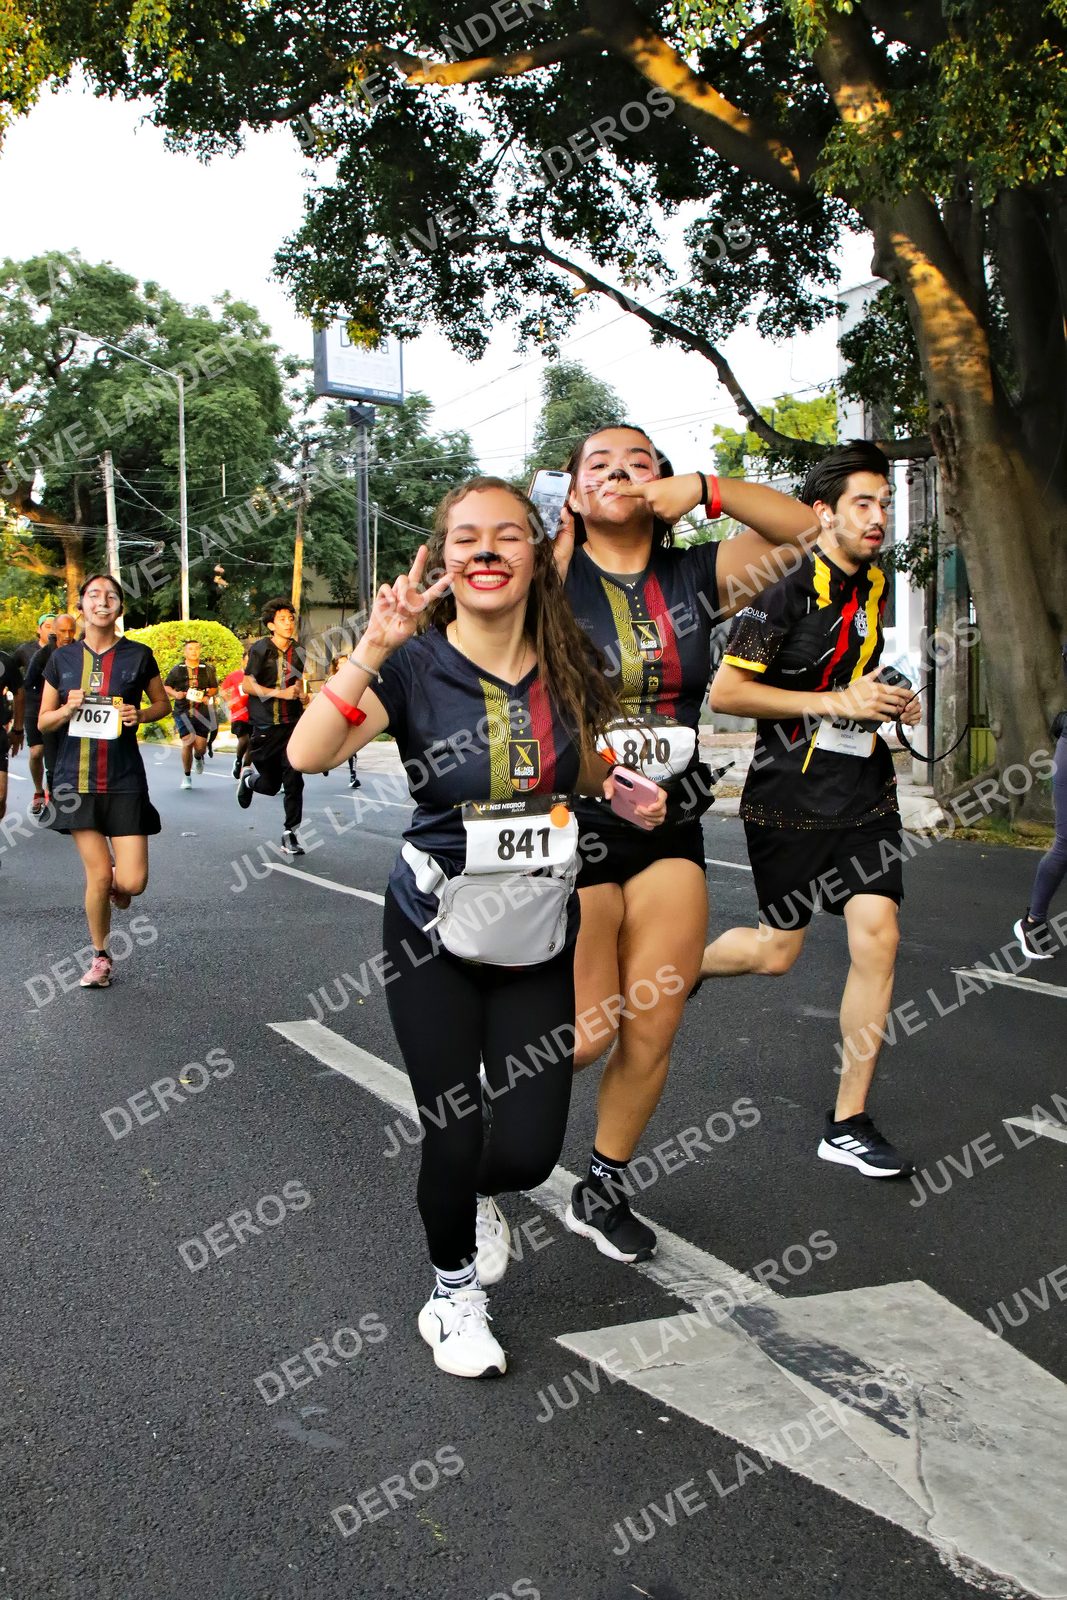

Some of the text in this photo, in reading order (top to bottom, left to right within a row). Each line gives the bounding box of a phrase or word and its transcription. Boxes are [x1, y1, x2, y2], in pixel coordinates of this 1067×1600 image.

[76, 709, 111, 724] 7067
[623, 738, 671, 766] 840
[497, 827, 551, 860] 841
